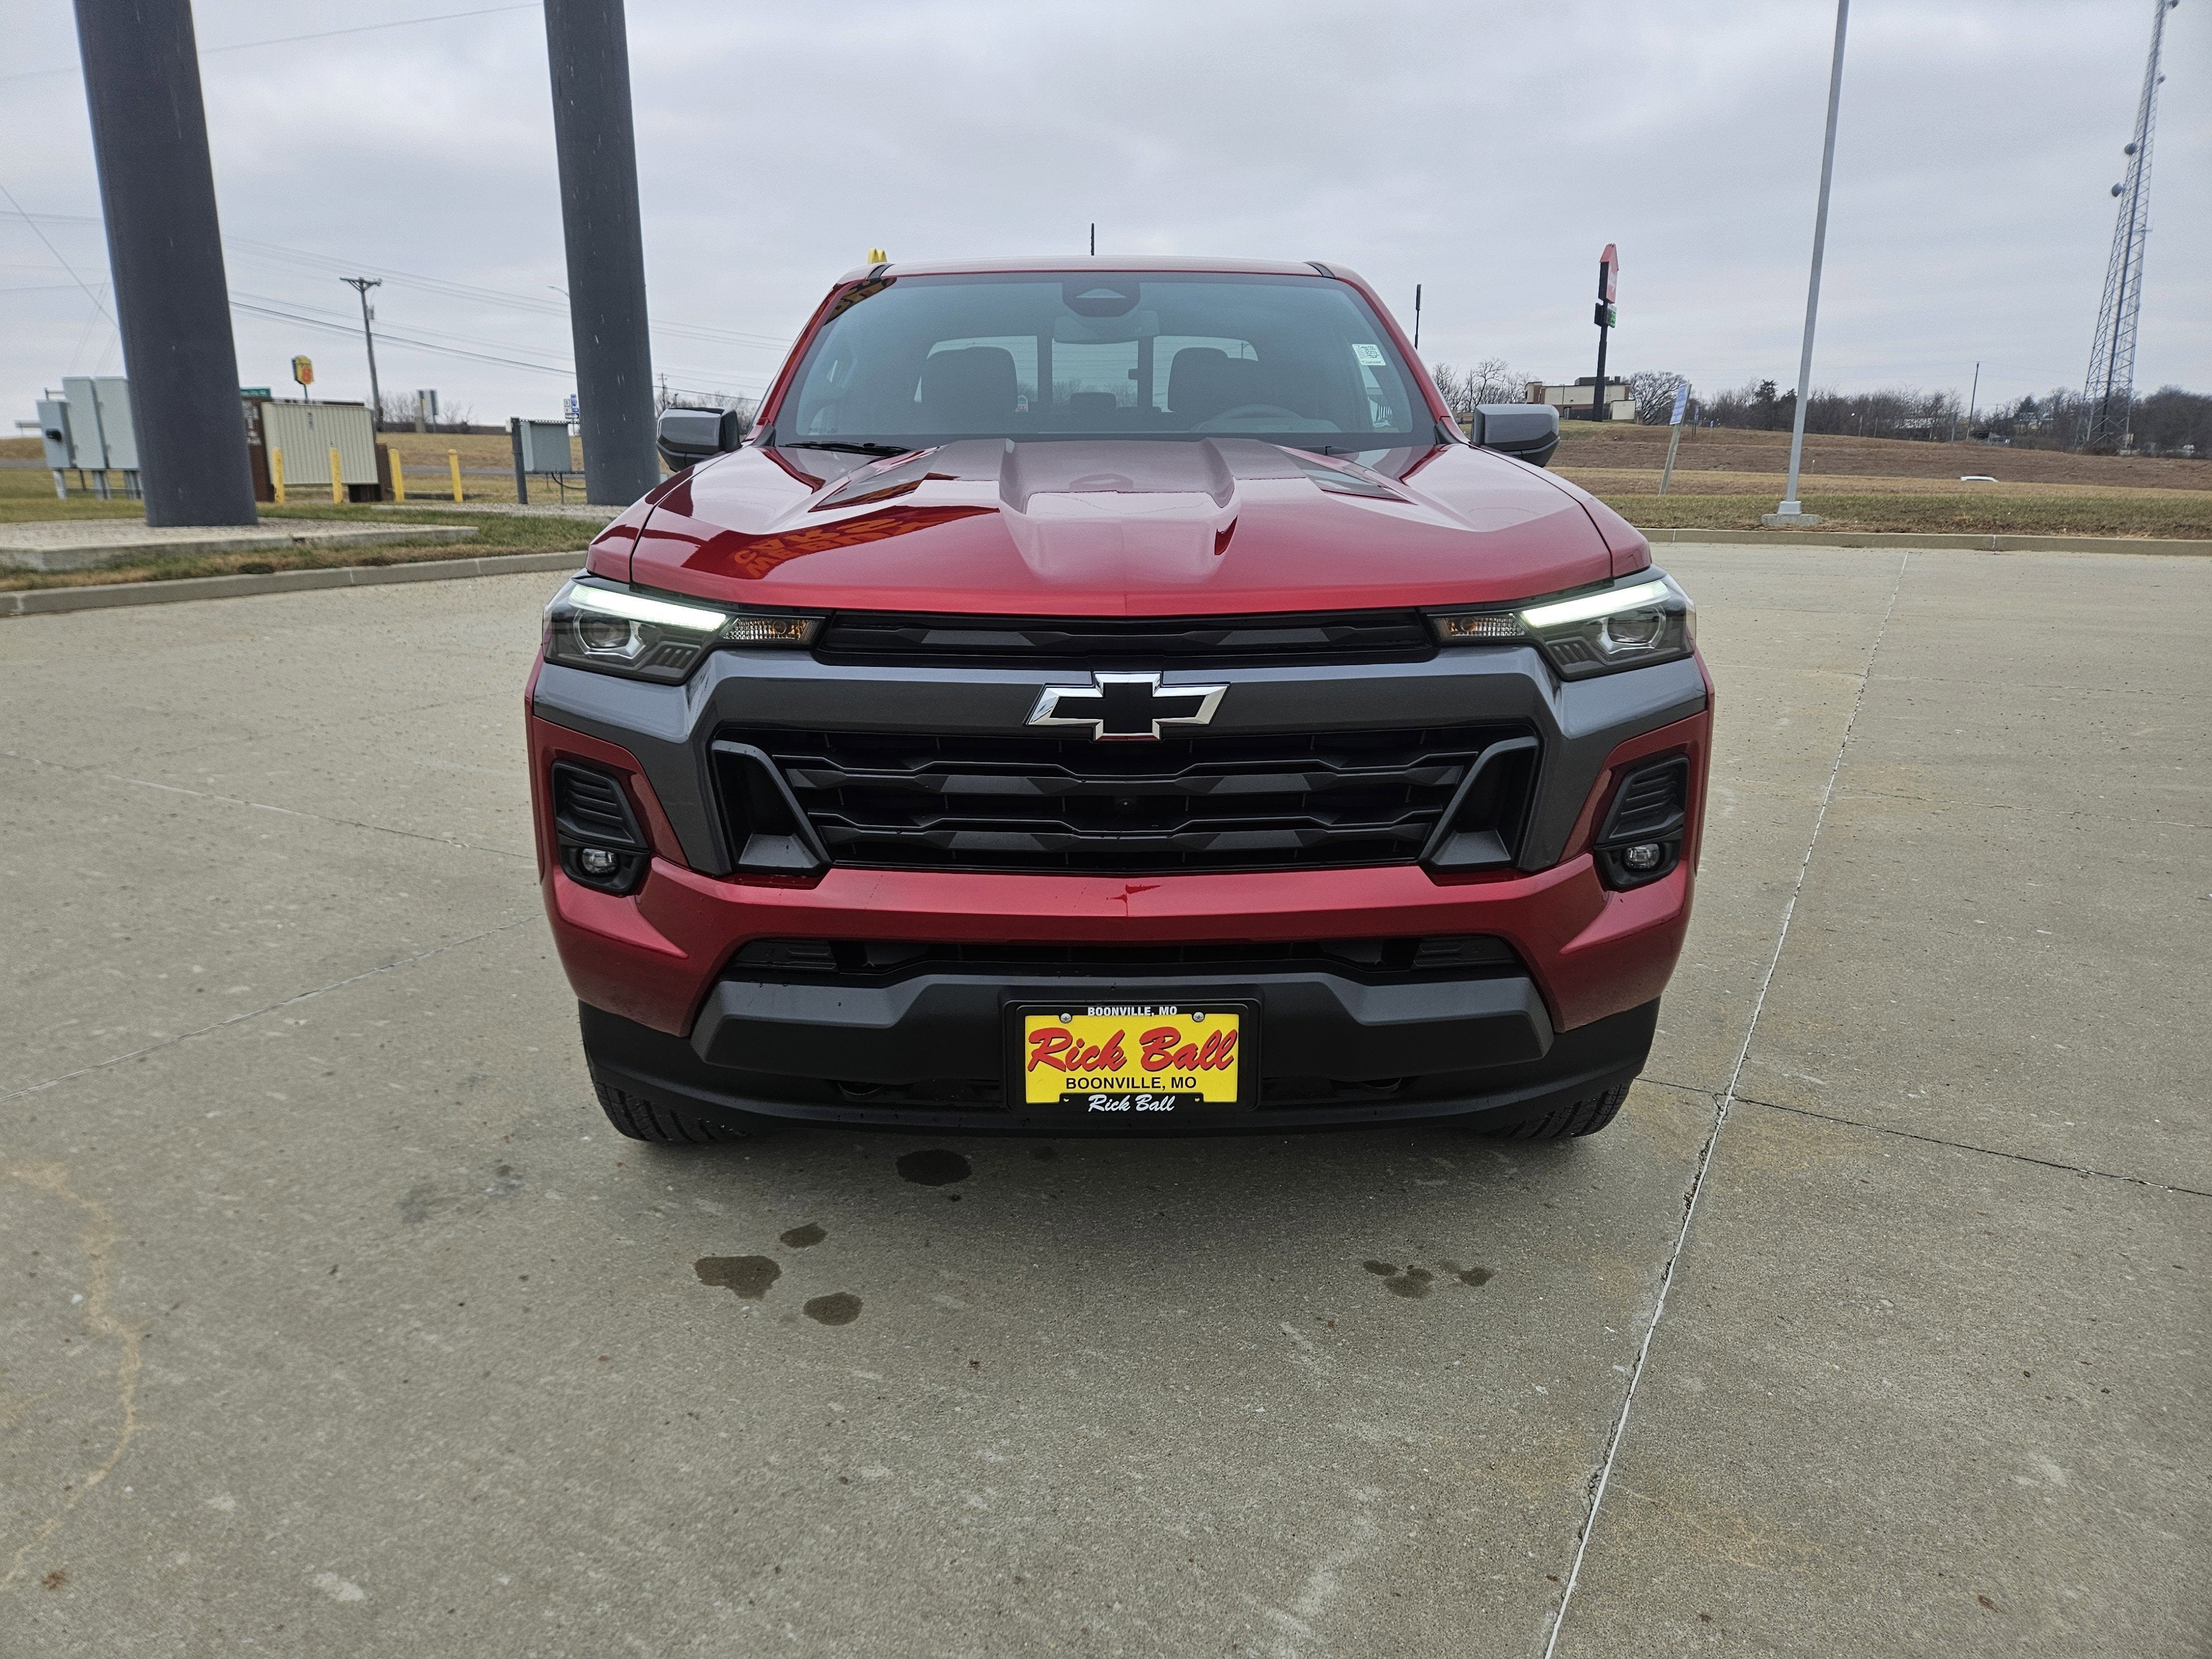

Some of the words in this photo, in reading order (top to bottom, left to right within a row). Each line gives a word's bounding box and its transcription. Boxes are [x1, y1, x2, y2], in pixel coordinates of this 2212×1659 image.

[1088, 1006, 1155, 1017] BOONVILLE,
[1159, 1006, 1178, 1016] MO
[1027, 1027, 1128, 1072] Rick
[1139, 1026, 1238, 1072] Ball
[1066, 1077, 1165, 1091] BOONVILLE,
[1171, 1076, 1197, 1089] MO
[1088, 1094, 1131, 1112] Rick
[1135, 1094, 1176, 1112] Ball
